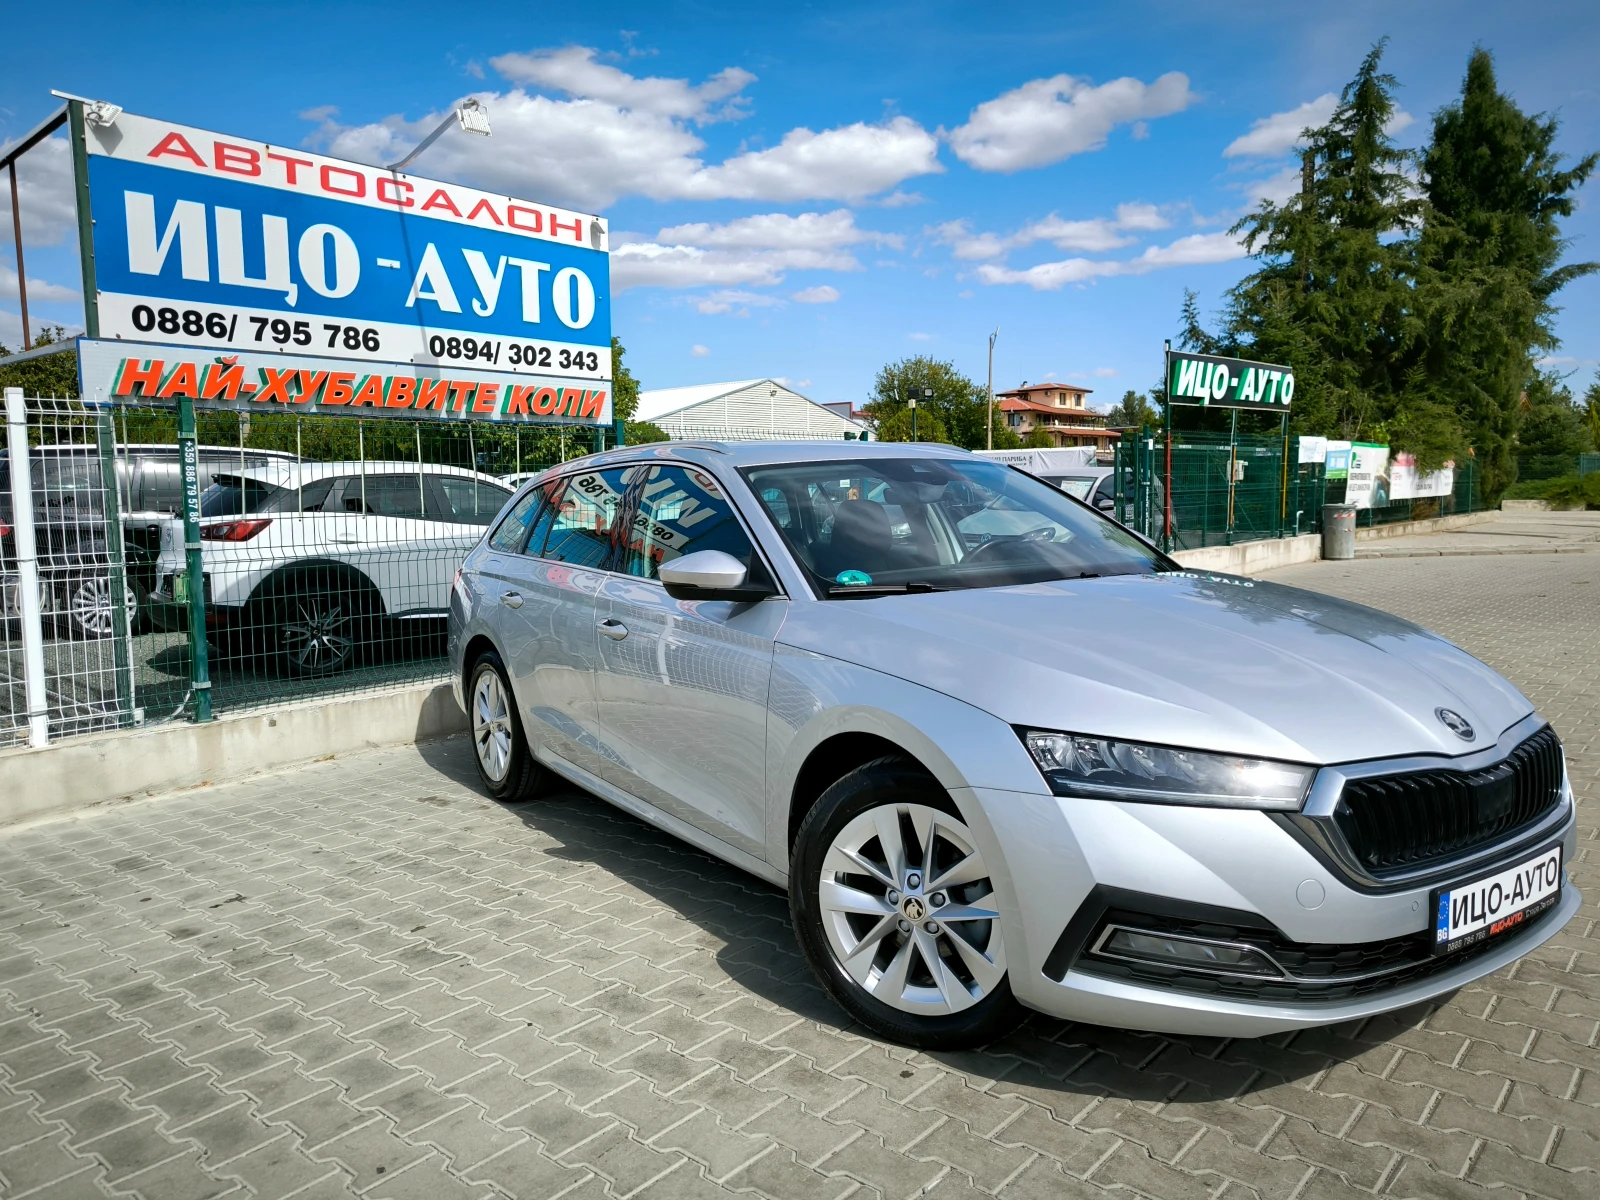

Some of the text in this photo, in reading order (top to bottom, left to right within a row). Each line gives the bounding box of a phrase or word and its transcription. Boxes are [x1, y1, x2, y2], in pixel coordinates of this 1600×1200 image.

[147, 131, 583, 242] АВТОСАЛОН
[131, 304, 381, 352] 0886/ 795 786
[429, 334, 599, 372] 0894/ 302 343
[112, 355, 606, 418] НАЙ-ХУБАВИТЕ КОЛИ
[1172, 358, 1295, 406] ИЦО-АУТО
[184, 440, 199, 523] +359 886 79 57 86
[1451, 856, 1558, 930] ИЦО-АУТО
[1437, 926, 1448, 942] BG
[1489, 911, 1524, 935] ИЦО-АУТО
